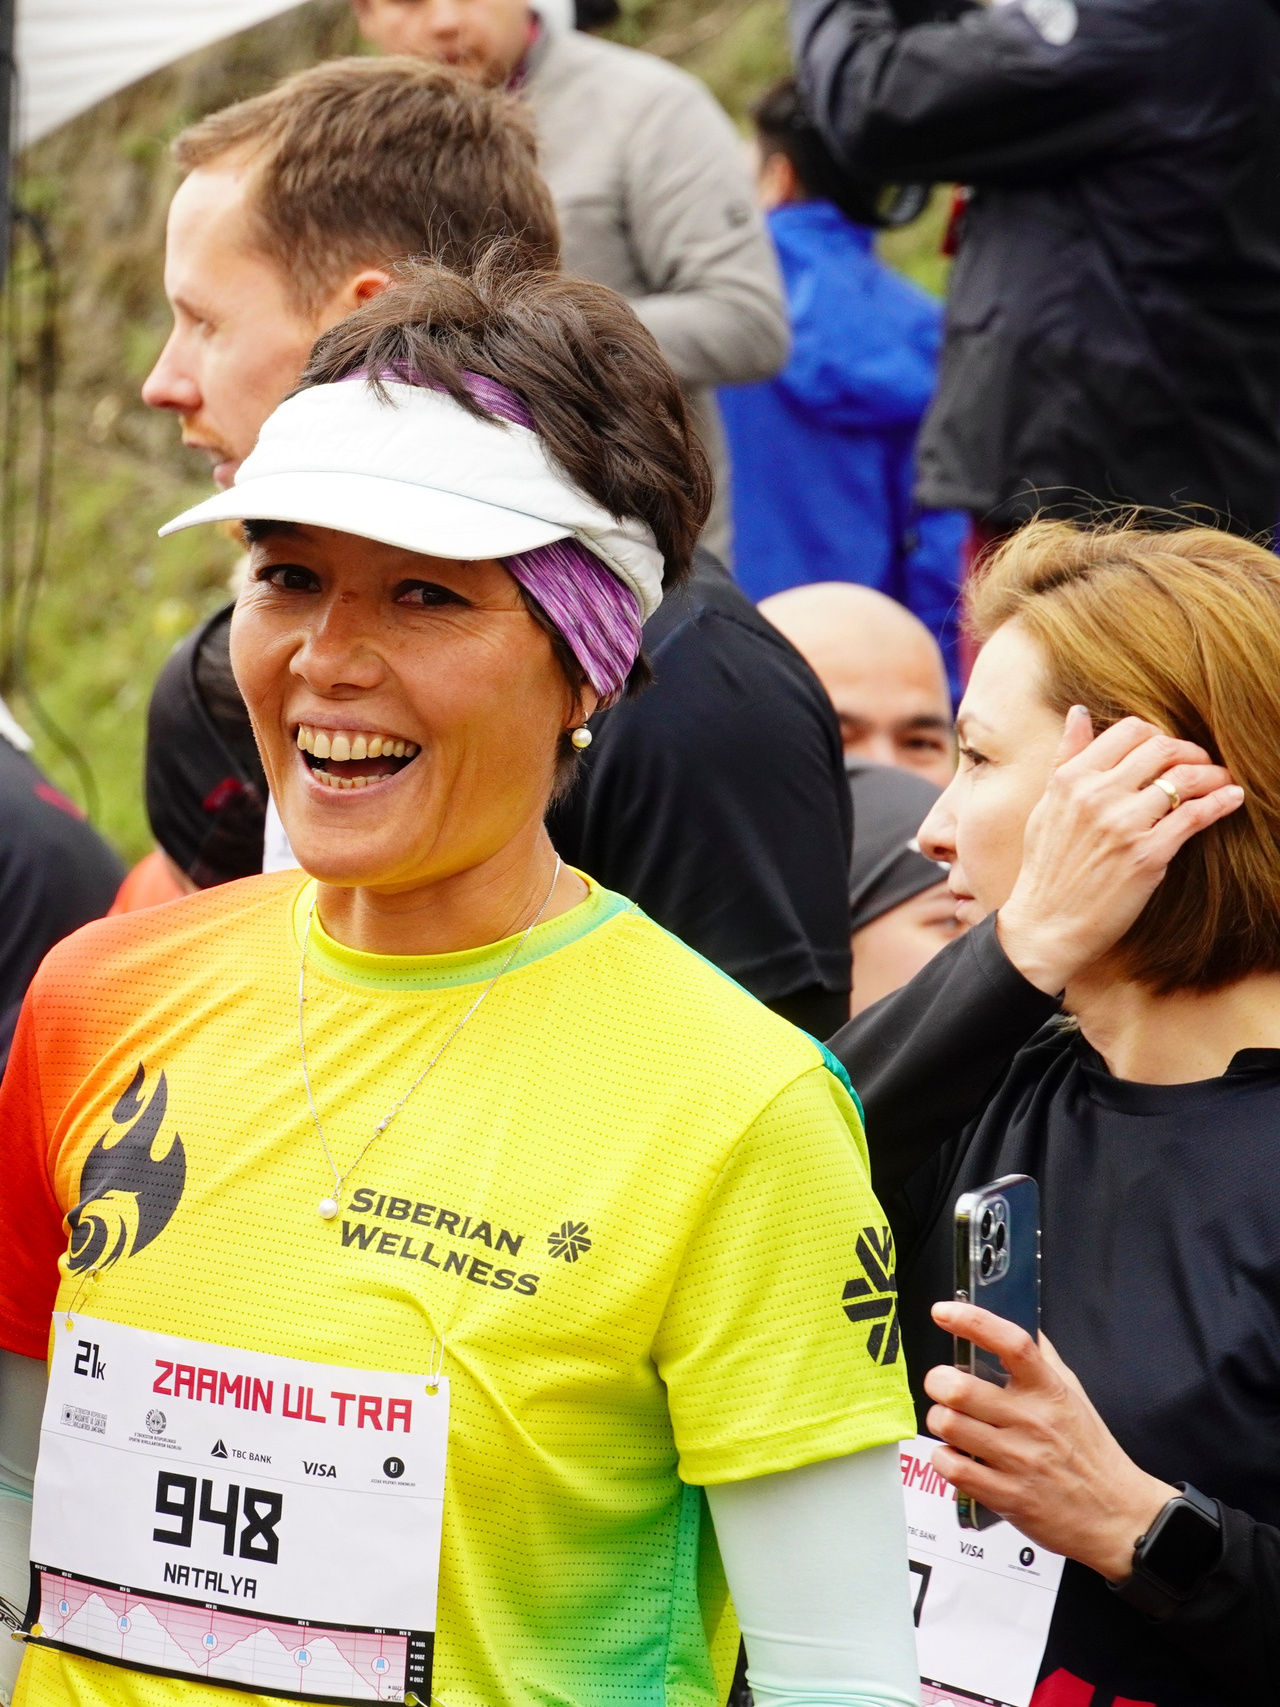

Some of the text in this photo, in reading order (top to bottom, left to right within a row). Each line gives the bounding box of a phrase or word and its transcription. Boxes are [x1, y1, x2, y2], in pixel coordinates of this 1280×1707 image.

[347, 1187, 525, 1257] SIBERIAN
[340, 1220, 540, 1296] WELLNESS
[152, 1359, 412, 1433] ZAAMIN ULTRA
[232, 1449, 272, 1464] TBC BANK
[302, 1460, 337, 1478] VISA
[153, 1471, 283, 1564] 948
[959, 1541, 984, 1559] VISA
[164, 1562, 257, 1599] NATALYA
